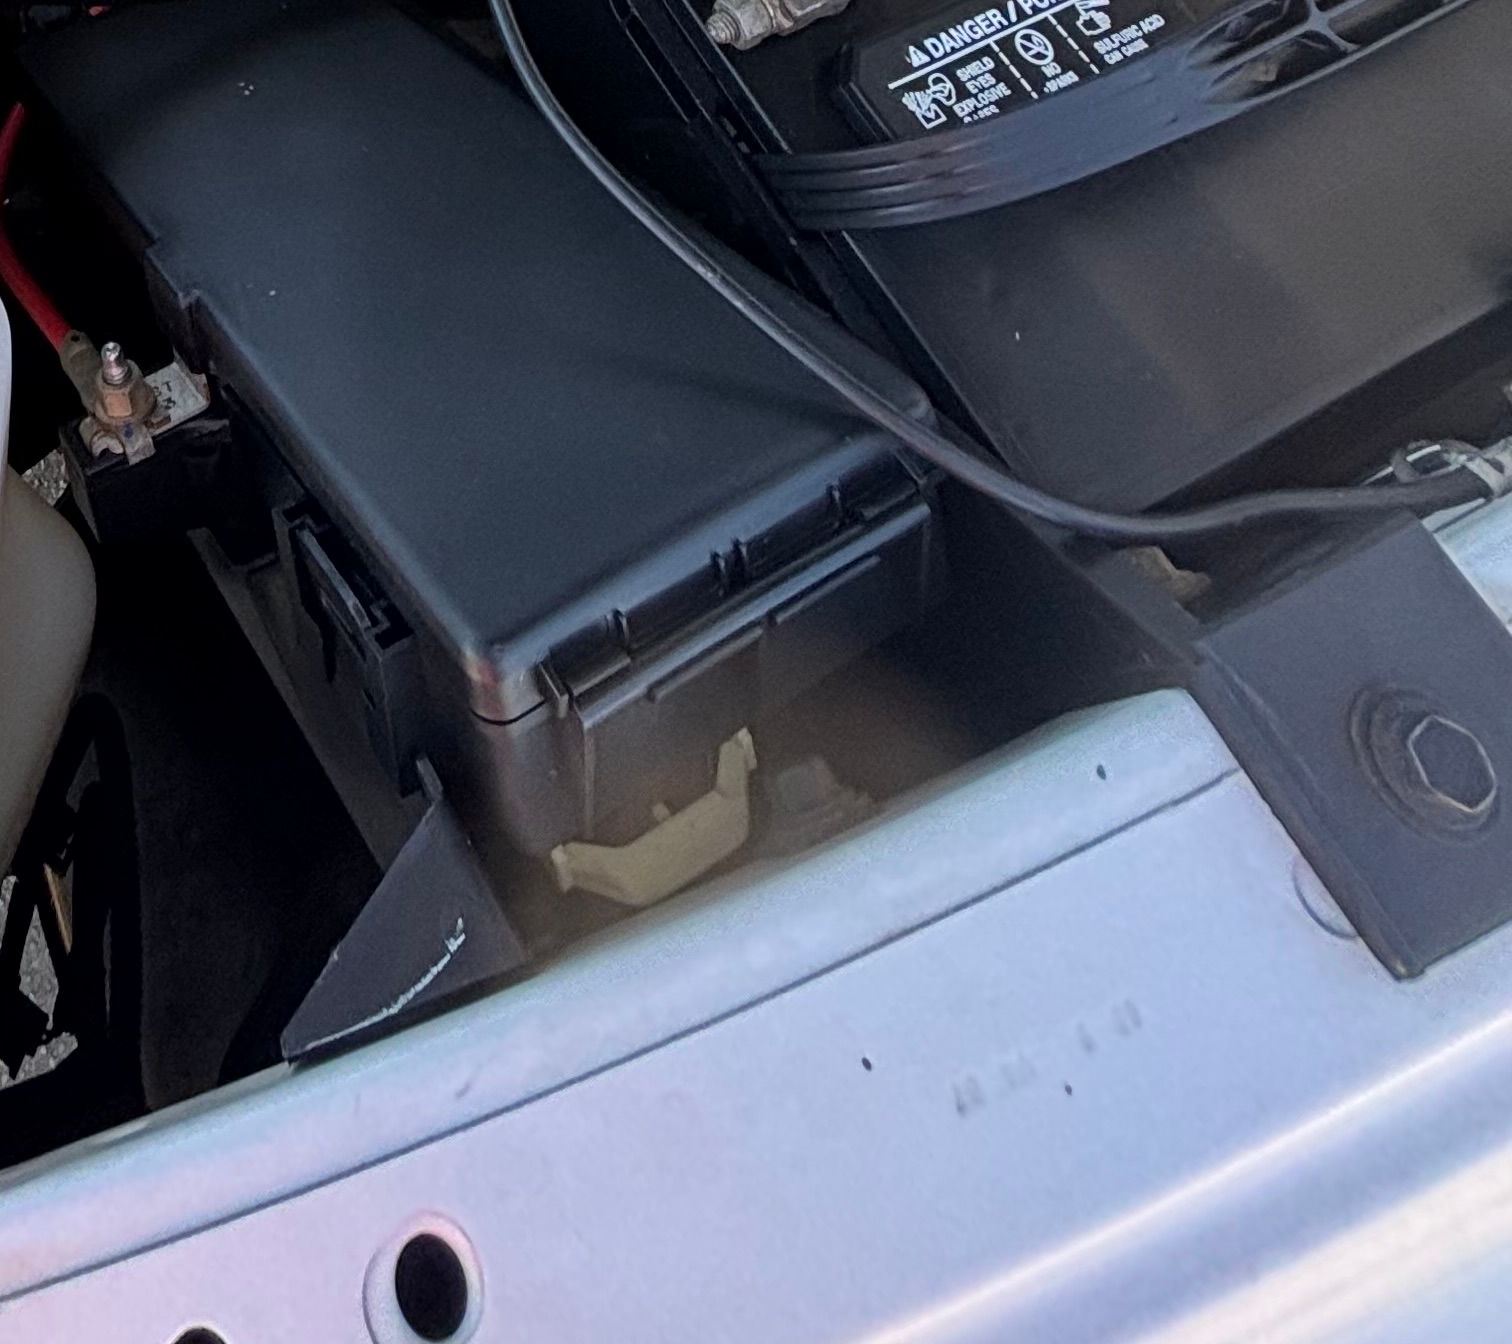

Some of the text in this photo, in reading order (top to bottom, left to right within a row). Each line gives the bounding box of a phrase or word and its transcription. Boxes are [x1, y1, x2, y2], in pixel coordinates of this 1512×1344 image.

[920, 5, 1011, 60] DANGER
[1092, 11, 1166, 56] SULFURIC ACID
[954, 54, 997, 83] SHIELD
[1040, 60, 1062, 79] NO
[1102, 48, 1123, 66] CAN
[964, 71, 998, 95] EYES
[950, 80, 1013, 118] EXPLOSIVE
